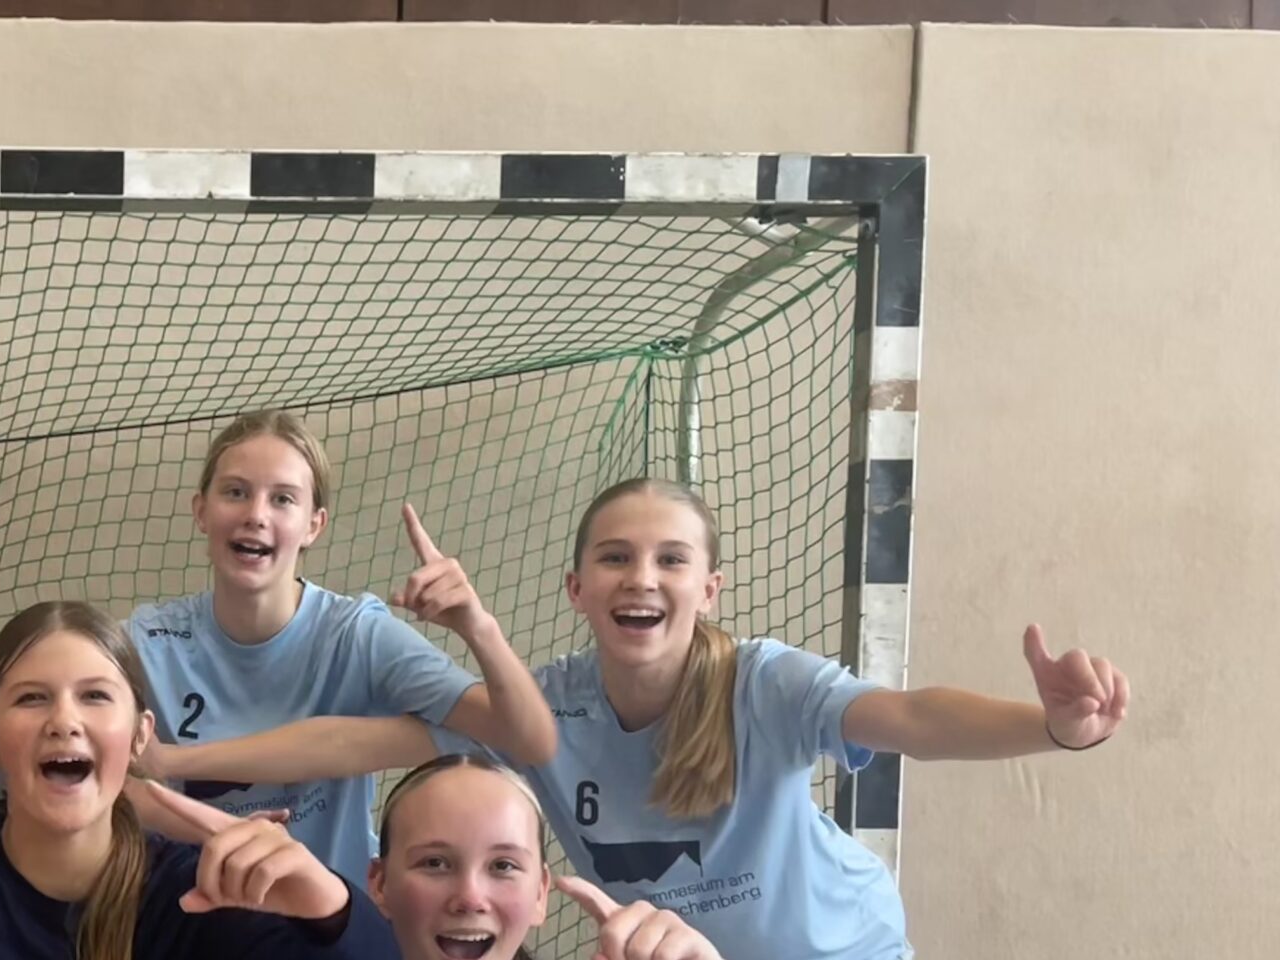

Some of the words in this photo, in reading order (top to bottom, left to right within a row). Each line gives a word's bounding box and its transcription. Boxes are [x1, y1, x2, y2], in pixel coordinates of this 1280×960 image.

[177, 692, 205, 740] 2
[575, 780, 600, 826] 6
[728, 871, 756, 887] am
[678, 885, 763, 917] chenberg
